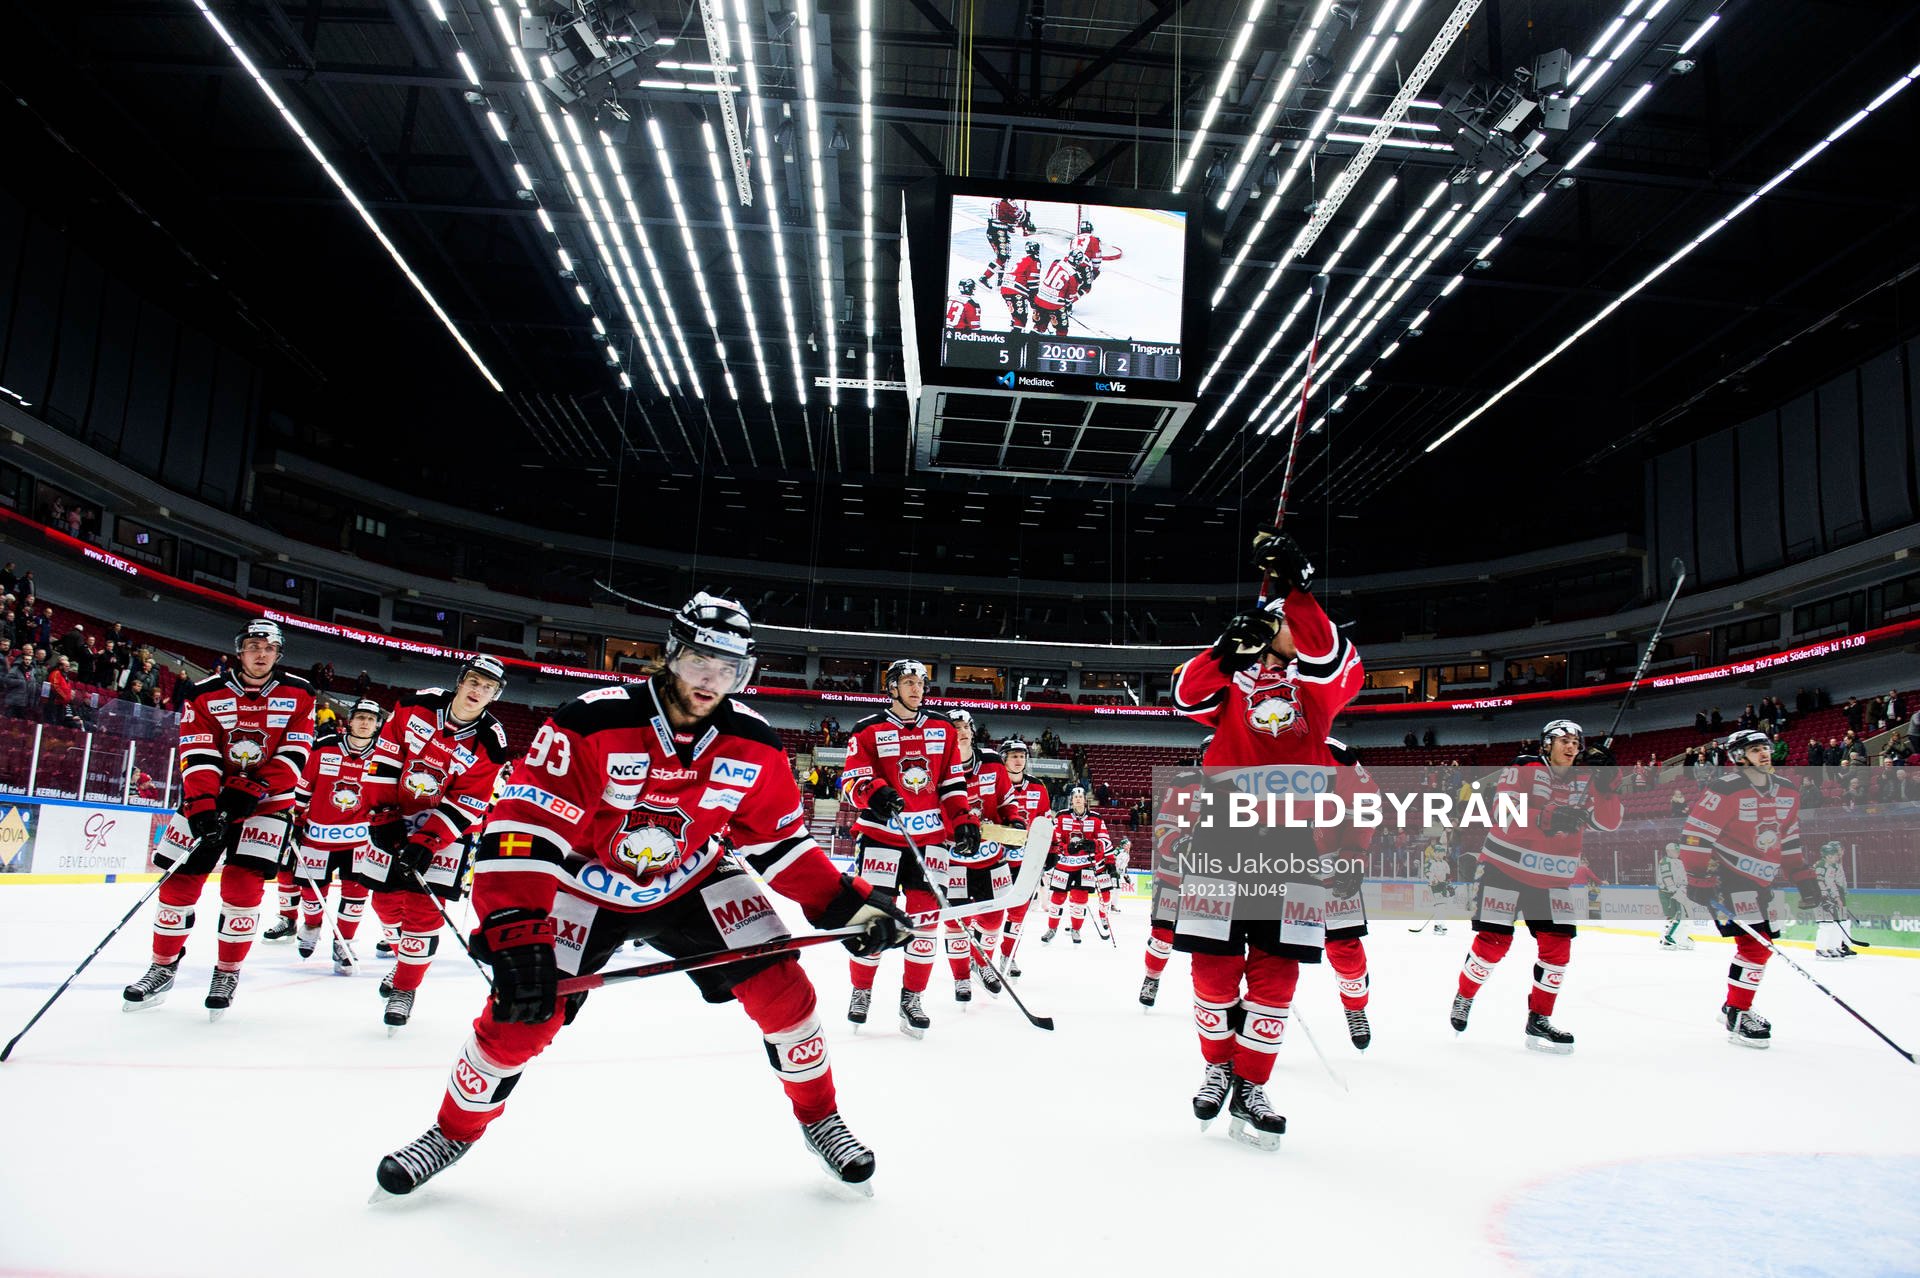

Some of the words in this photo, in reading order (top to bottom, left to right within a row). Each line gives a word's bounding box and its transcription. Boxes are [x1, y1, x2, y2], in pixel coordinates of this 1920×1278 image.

[954, 331, 1006, 344] Redhawks
[1042, 344, 1086, 360] 20:00
[1130, 343, 1175, 356] Tingsryd
[999, 350, 1009, 364] 5
[1058, 360, 1068, 372] 3
[1117, 358, 1128, 372] 2
[1018, 376, 1055, 388] Mediatec
[1095, 381, 1127, 393] tecViz
[83, 547, 139, 577] www.TICNET.se
[263, 609, 285, 625] Nästa
[285, 615, 340, 637] hemmamatch:
[342, 628, 366, 644] Tisdag
[367, 634, 385, 647] 26/2
[385, 639, 400, 650] mot
[401, 641, 442, 658] Södertälje
[443, 647, 452, 658] kl
[1653, 678, 1674, 688] Nästa
[1675, 667, 1730, 685] hemmamatch:
[1731, 662, 1755, 676] Tisdag
[1755, 657, 1773, 670] 26/2
[1773, 655, 1789, 665] mot
[1789, 644, 1830, 662] Södertälje
[1830, 641, 1839, 652] kl
[1841, 635, 1866, 650] 19.00
[540, 665, 563, 676] Nästa
[564, 666, 620, 682] hemmamatch:
[821, 692, 843, 702] Nästa
[209, 703, 229, 713] NCC
[924, 698, 942, 707] 26/2
[943, 700, 959, 708] mot
[960, 699, 999, 710] Södertälje
[1000, 701, 1008, 710] kl
[1009, 702, 1031, 712] 19.00
[1451, 698, 1513, 711] www.TICNET.se
[1094, 707, 1116, 715] Nästa
[1116, 707, 1170, 717] hemmamatch:
[408, 720, 427, 735] NCC
[877, 735, 893, 743] NCC
[524, 725, 571, 777] 93
[610, 764, 641, 776] NCC
[1235, 769, 1327, 795] areco
[0, 827, 24, 843] OVA
[241, 826, 283, 846] MAXI
[309, 825, 368, 840] areco
[58, 855, 128, 869] DEVELOPMENT
[863, 858, 898, 873] MAXI
[1182, 893, 1232, 917] MAXI
[1284, 900, 1323, 922] MAX
[1325, 898, 1361, 914] MAXI
[1604, 902, 1660, 916] CLIMAT80
[157, 911, 180, 923] AXA
[229, 918, 255, 930] AXA
[402, 938, 424, 950] AXA
[554, 936, 582, 952] RKNAD
[913, 941, 934, 951] AXA
[951, 940, 969, 949] AXA
[1254, 1019, 1284, 1035] AXA
[790, 1039, 824, 1064] AXA
[457, 1061, 483, 1093] AXA
